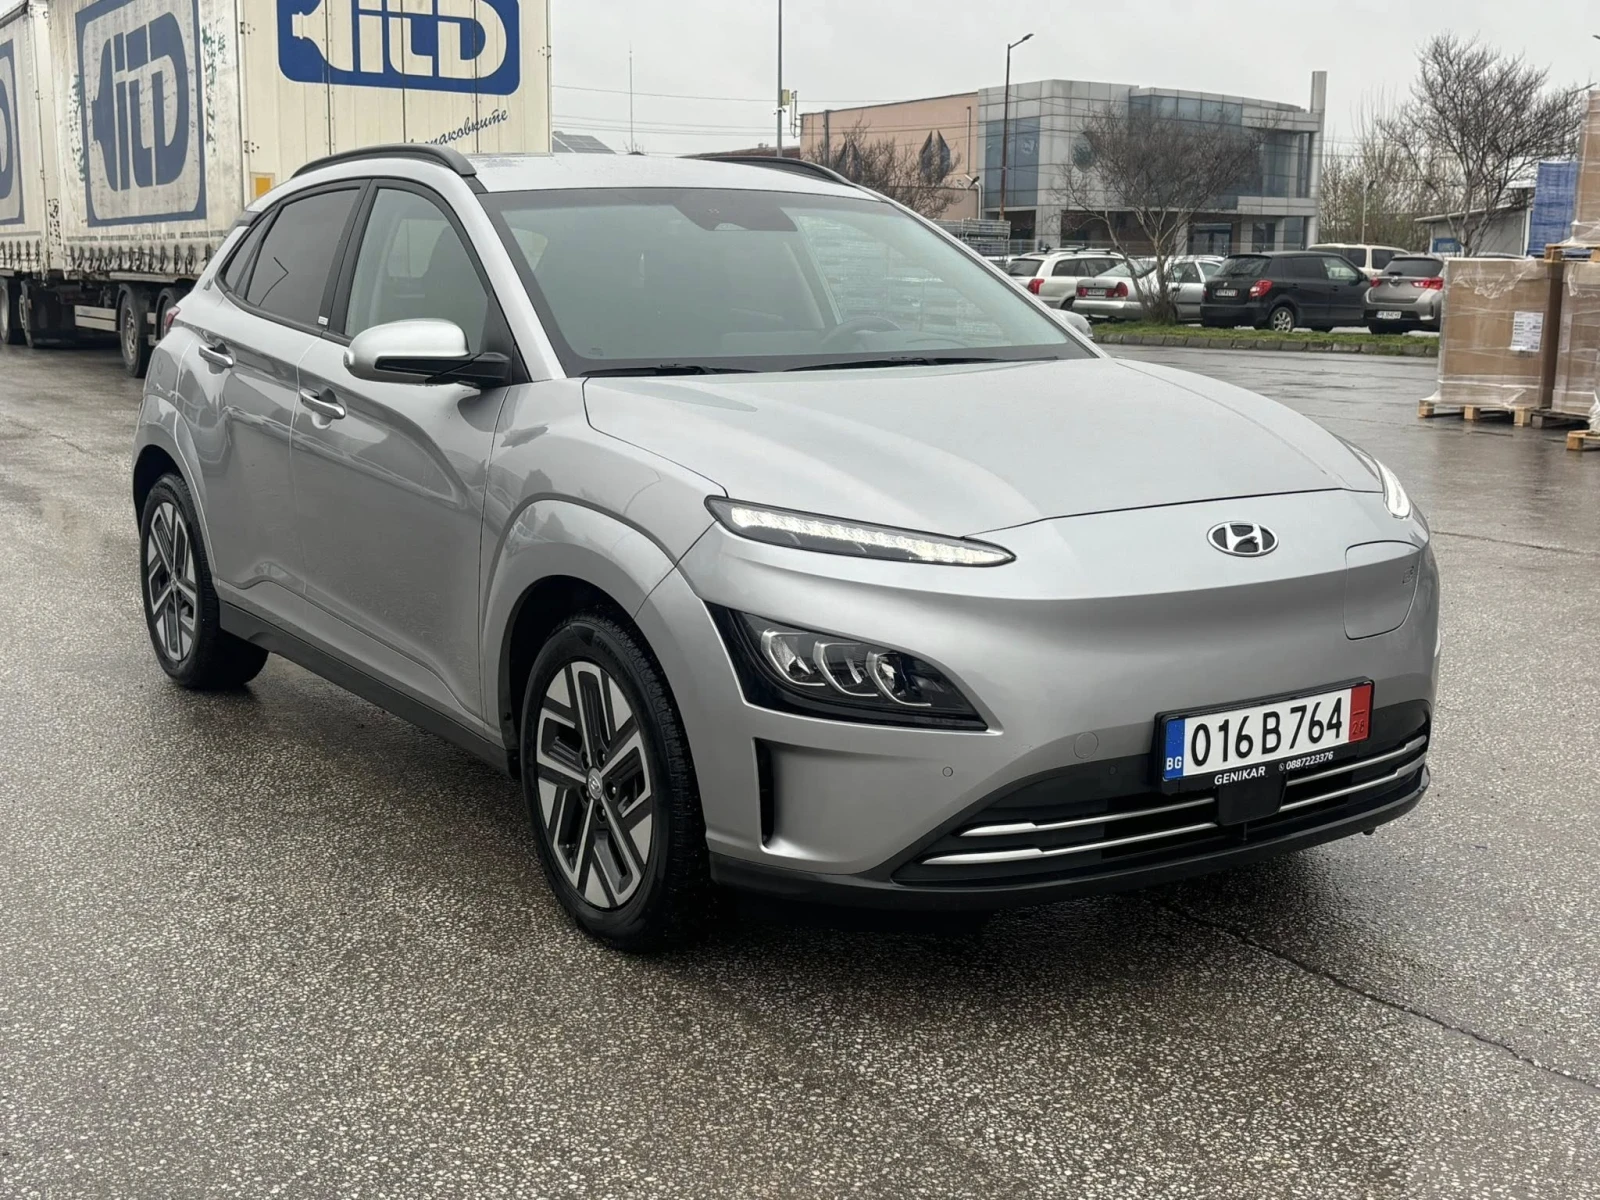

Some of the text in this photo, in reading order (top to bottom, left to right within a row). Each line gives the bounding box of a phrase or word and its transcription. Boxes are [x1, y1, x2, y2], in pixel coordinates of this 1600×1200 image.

[1191, 697, 1342, 767] 016B764
[1166, 757, 1182, 770] BG
[1214, 751, 1334, 785] GENIKAR 0887223376
